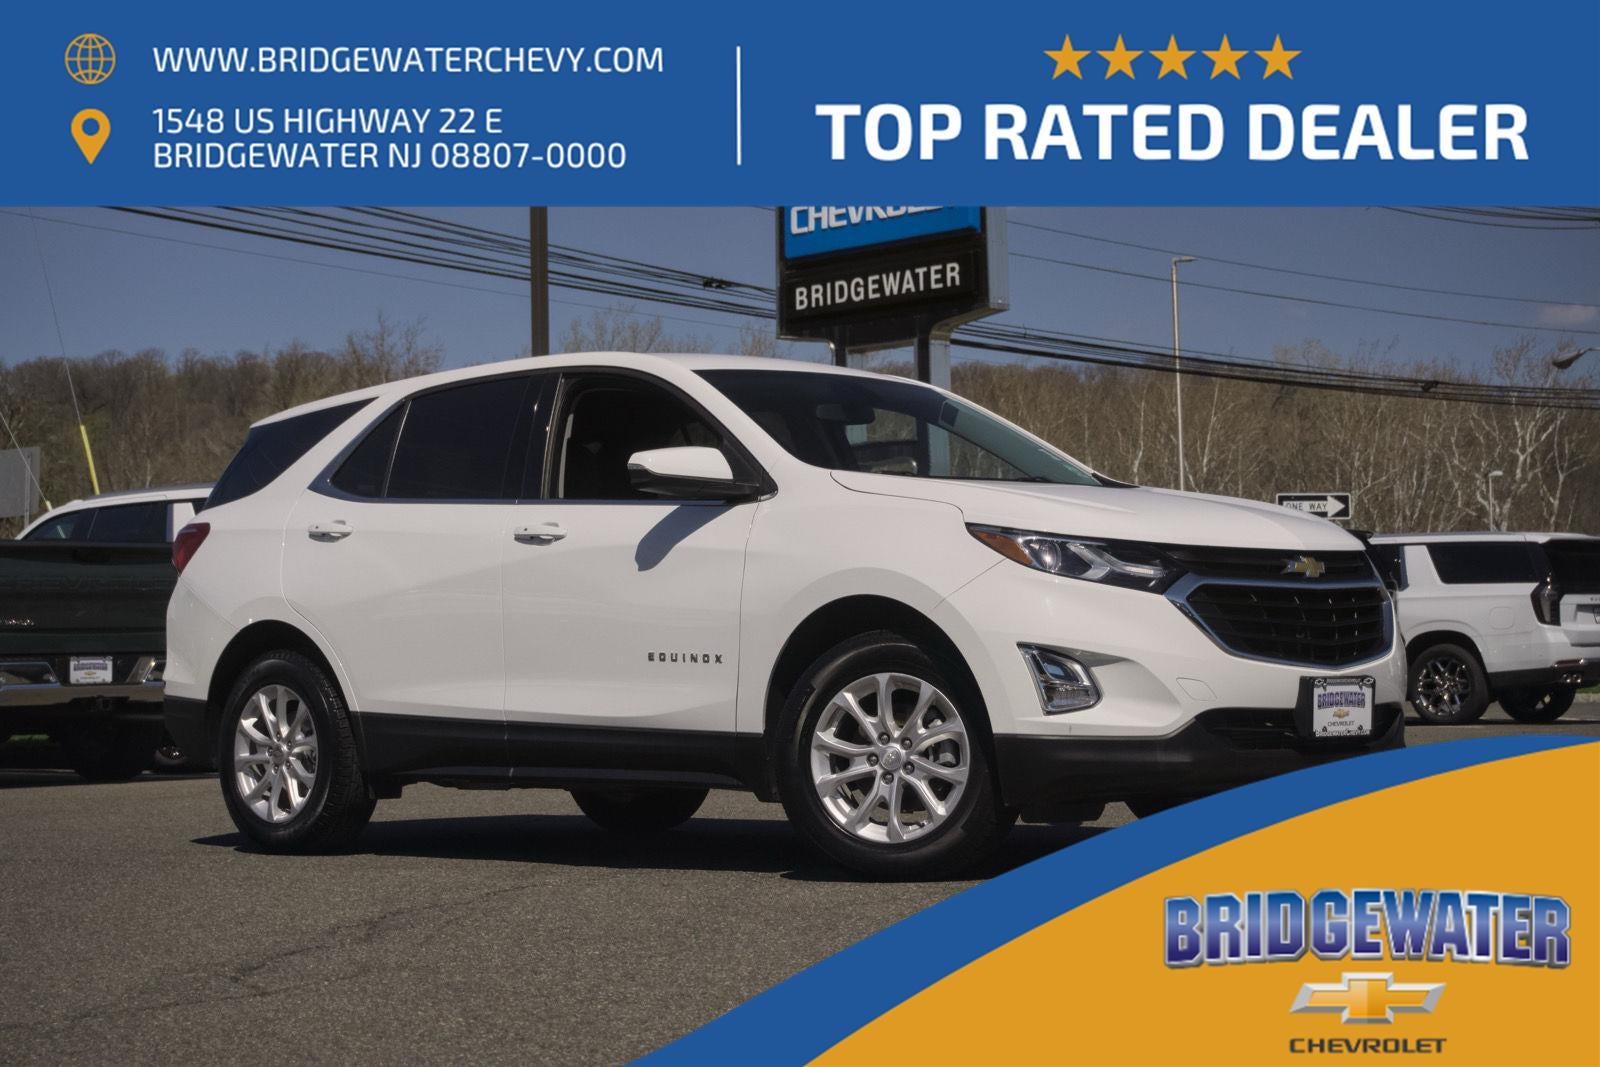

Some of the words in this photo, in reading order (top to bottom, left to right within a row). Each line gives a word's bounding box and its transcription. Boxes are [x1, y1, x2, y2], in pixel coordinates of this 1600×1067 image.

[790, 206, 944, 235] CHEVR
[795, 262, 961, 311] BRIDGEWATER
[1308, 502, 1328, 511] WAY
[648, 652, 722, 664] EQUINOX
[1317, 691, 1366, 710] BRIDGEWATER
